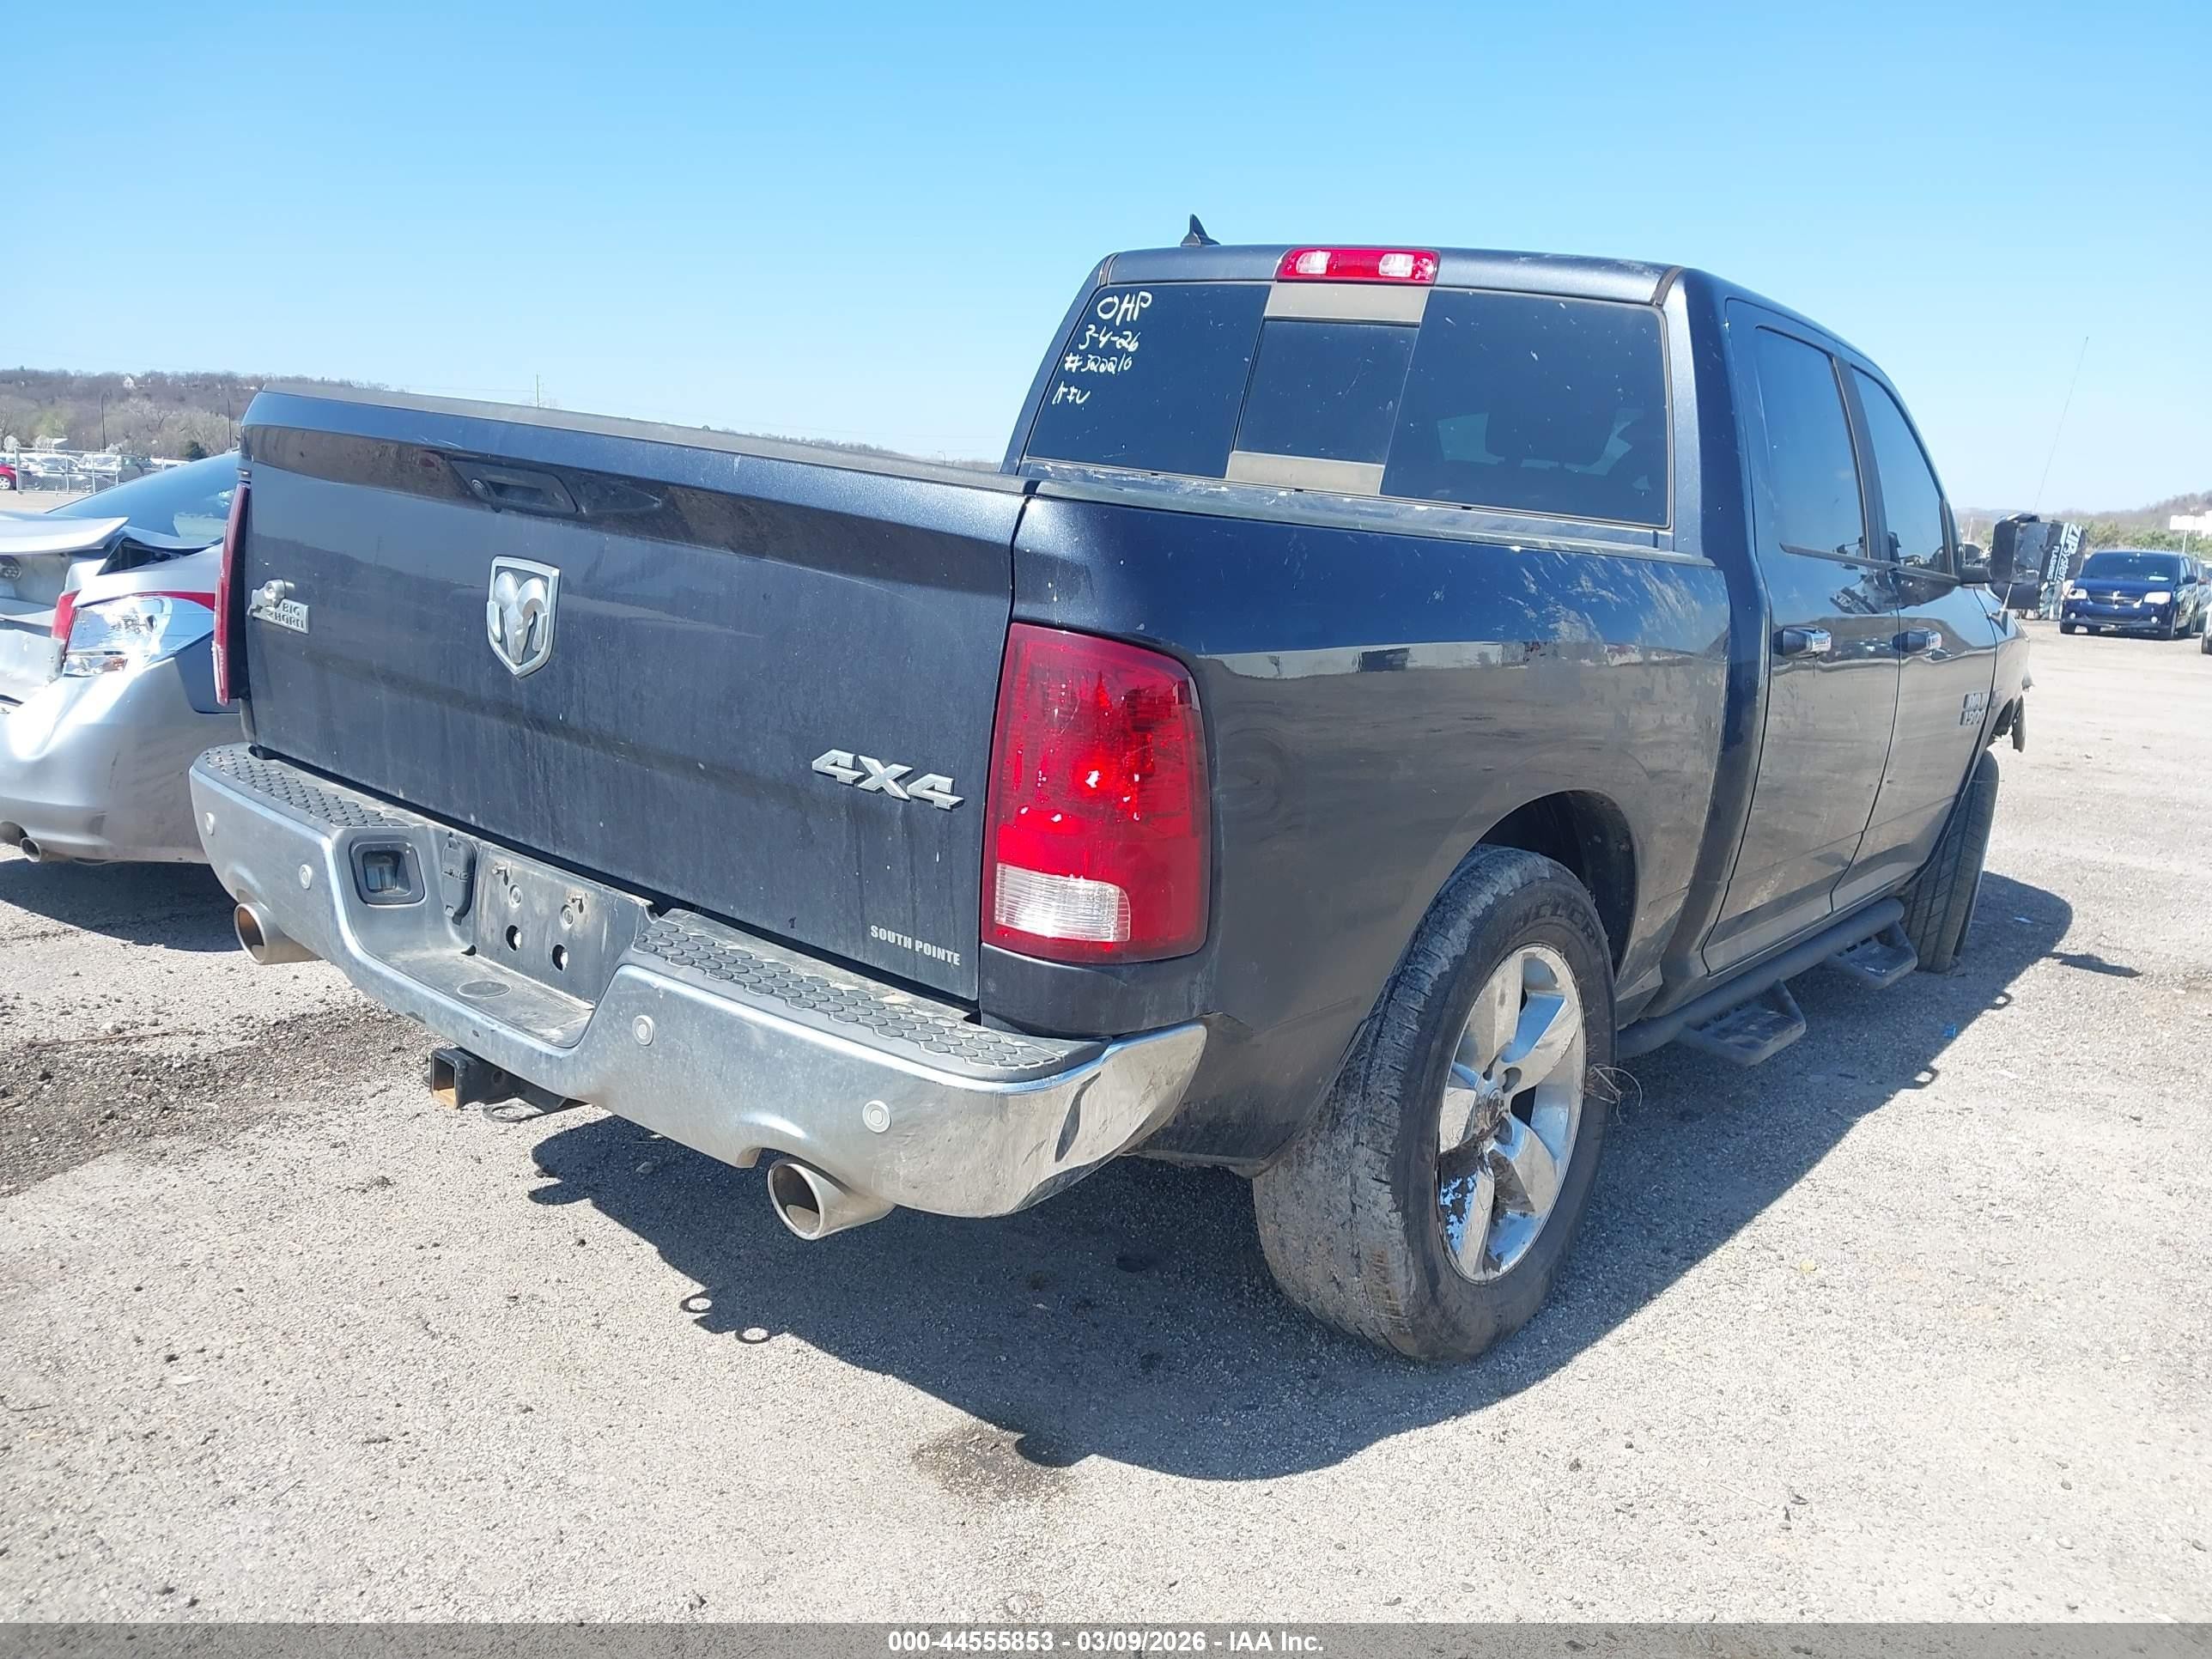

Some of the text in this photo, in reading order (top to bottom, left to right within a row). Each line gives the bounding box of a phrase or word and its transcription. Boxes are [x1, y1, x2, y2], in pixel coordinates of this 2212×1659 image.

[1097, 291, 1152, 326] OHP
[274, 611, 304, 629] HORN
[282, 603, 301, 616] BIG
[870, 925, 961, 966] SOUTH POINTE
